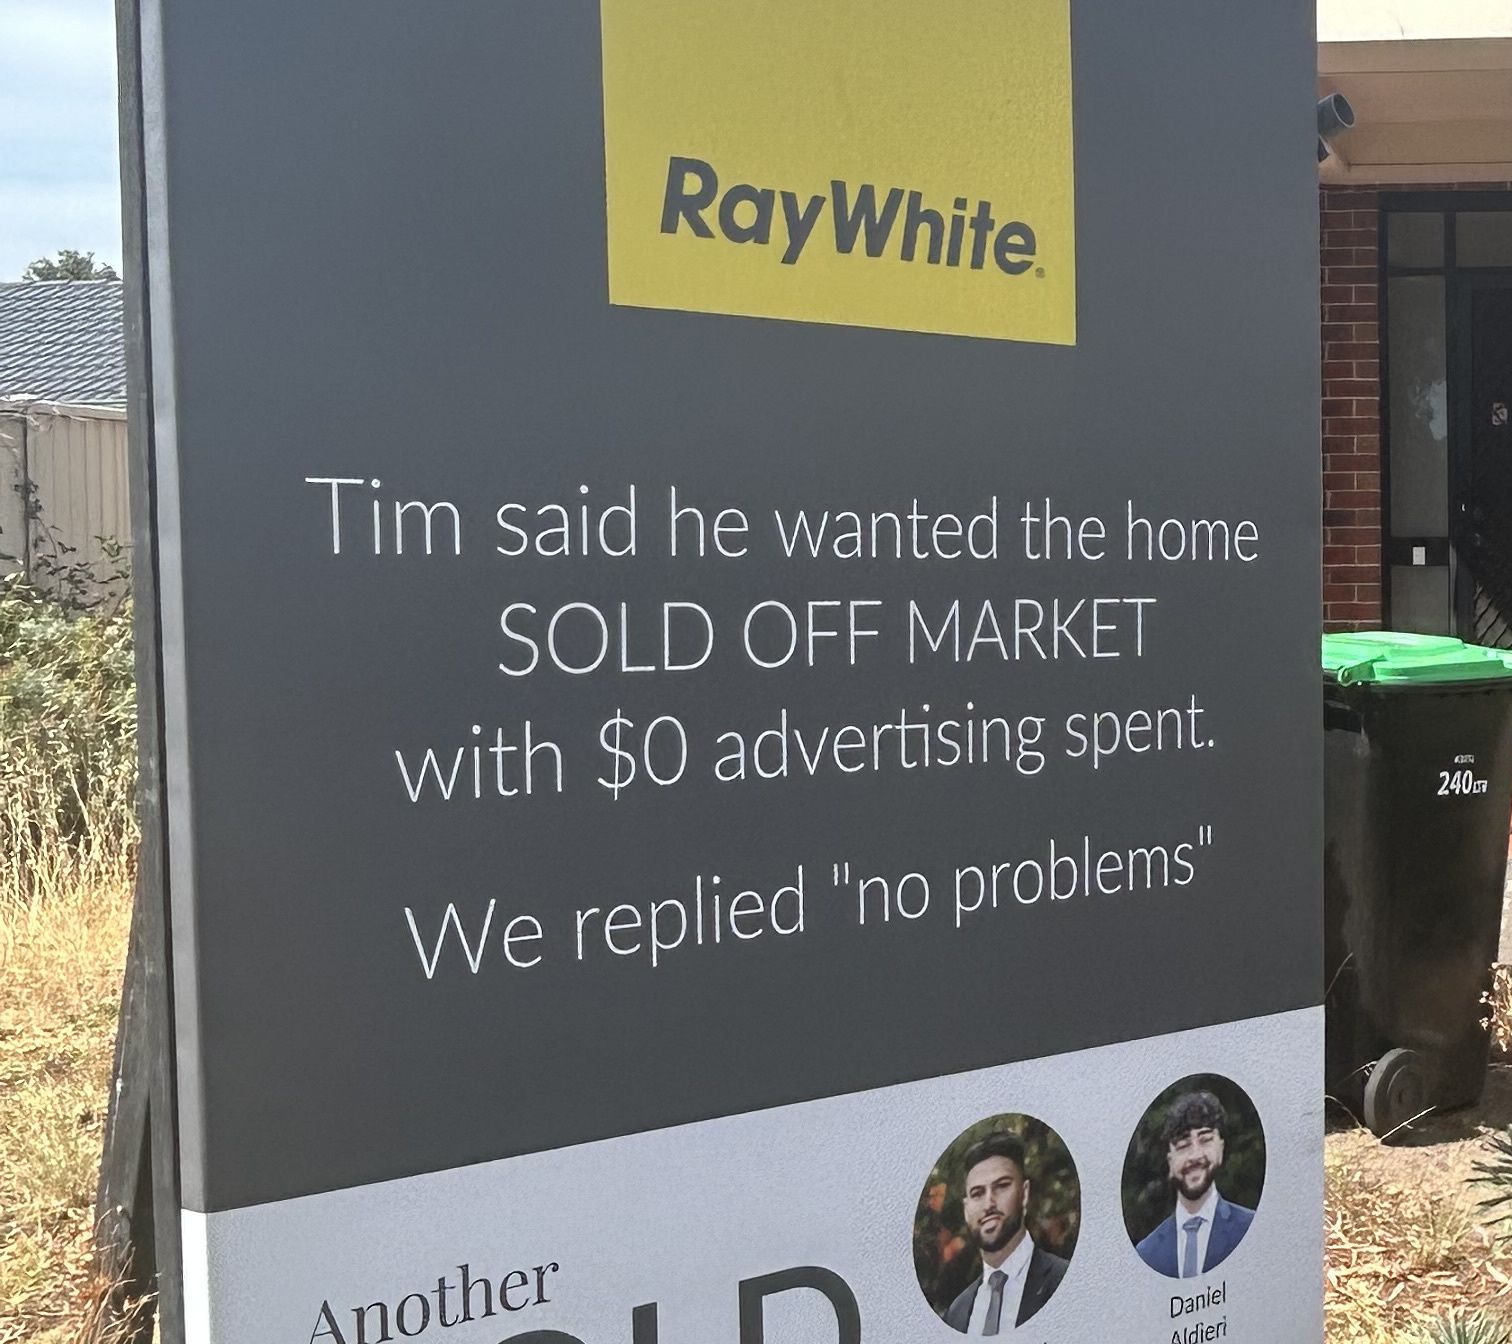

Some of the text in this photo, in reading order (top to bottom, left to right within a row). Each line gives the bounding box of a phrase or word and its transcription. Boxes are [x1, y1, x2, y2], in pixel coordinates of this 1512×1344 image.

[660, 155, 1037, 276] RayWhite
[304, 476, 1259, 562] Tim said he wanted the home
[498, 597, 1158, 677] SOLD OFF MARKET
[394, 693, 1216, 803] with $0 advertising spent.
[403, 824, 1213, 980] We replied "no problems"
[1169, 1280, 1227, 1319] Daniel
